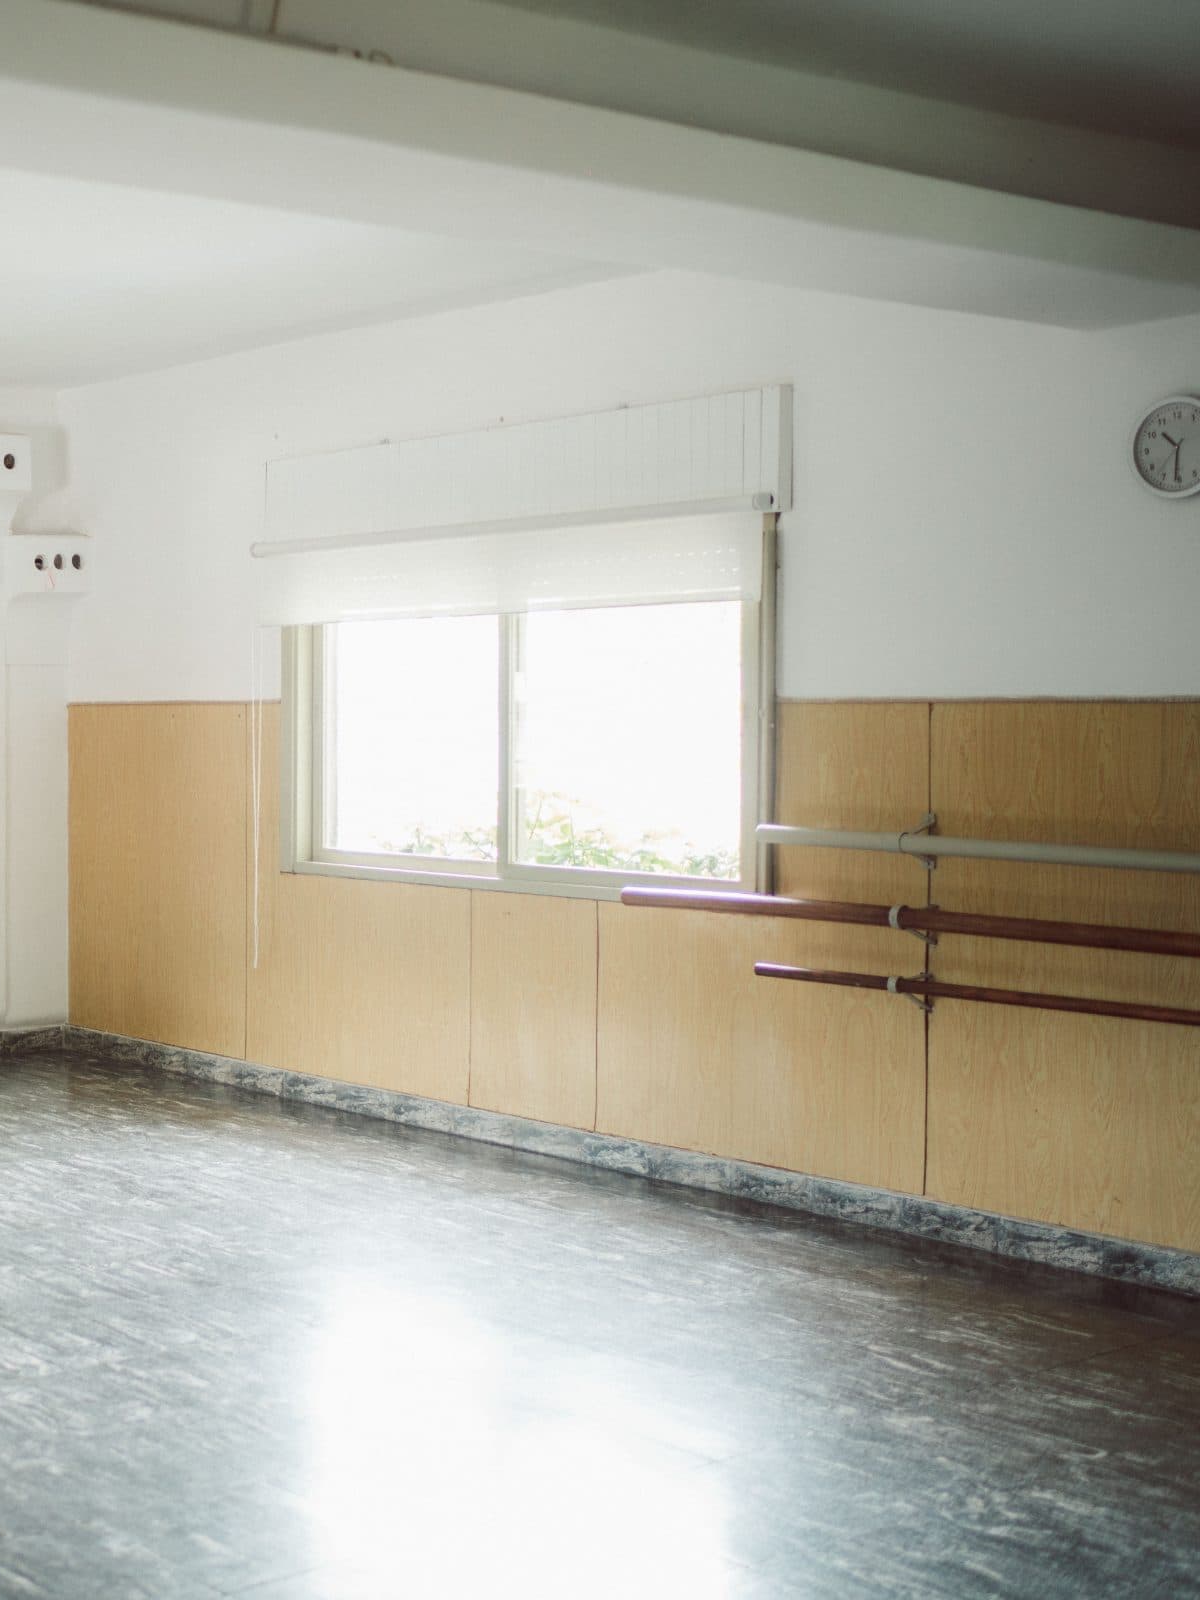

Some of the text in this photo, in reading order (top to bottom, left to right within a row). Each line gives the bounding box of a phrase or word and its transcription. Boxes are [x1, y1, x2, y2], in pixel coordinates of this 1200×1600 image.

[1173, 411, 1182, 419] 12
[1147, 431, 1157, 439] 10
[1144, 447, 1150, 455] 9
